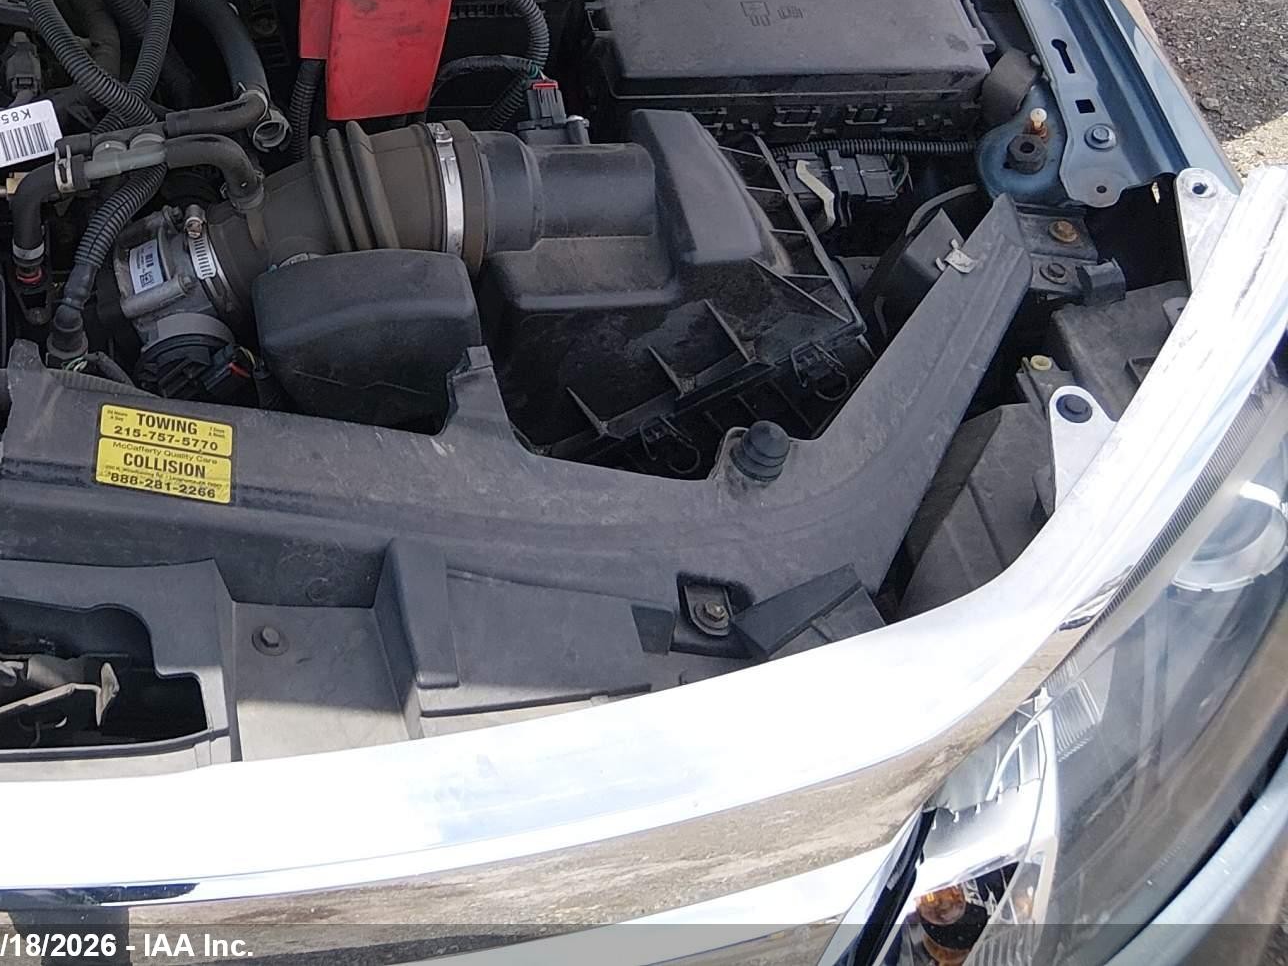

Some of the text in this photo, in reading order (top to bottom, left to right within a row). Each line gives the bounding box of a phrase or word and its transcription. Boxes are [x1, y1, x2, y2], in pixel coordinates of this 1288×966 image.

[1, 108, 32, 124] K85
[136, 412, 198, 435] TOWING
[114, 425, 218, 451] 215-757-5770
[112, 441, 218, 465] McCafferty Quality Care
[123, 452, 206, 479] COLLISION
